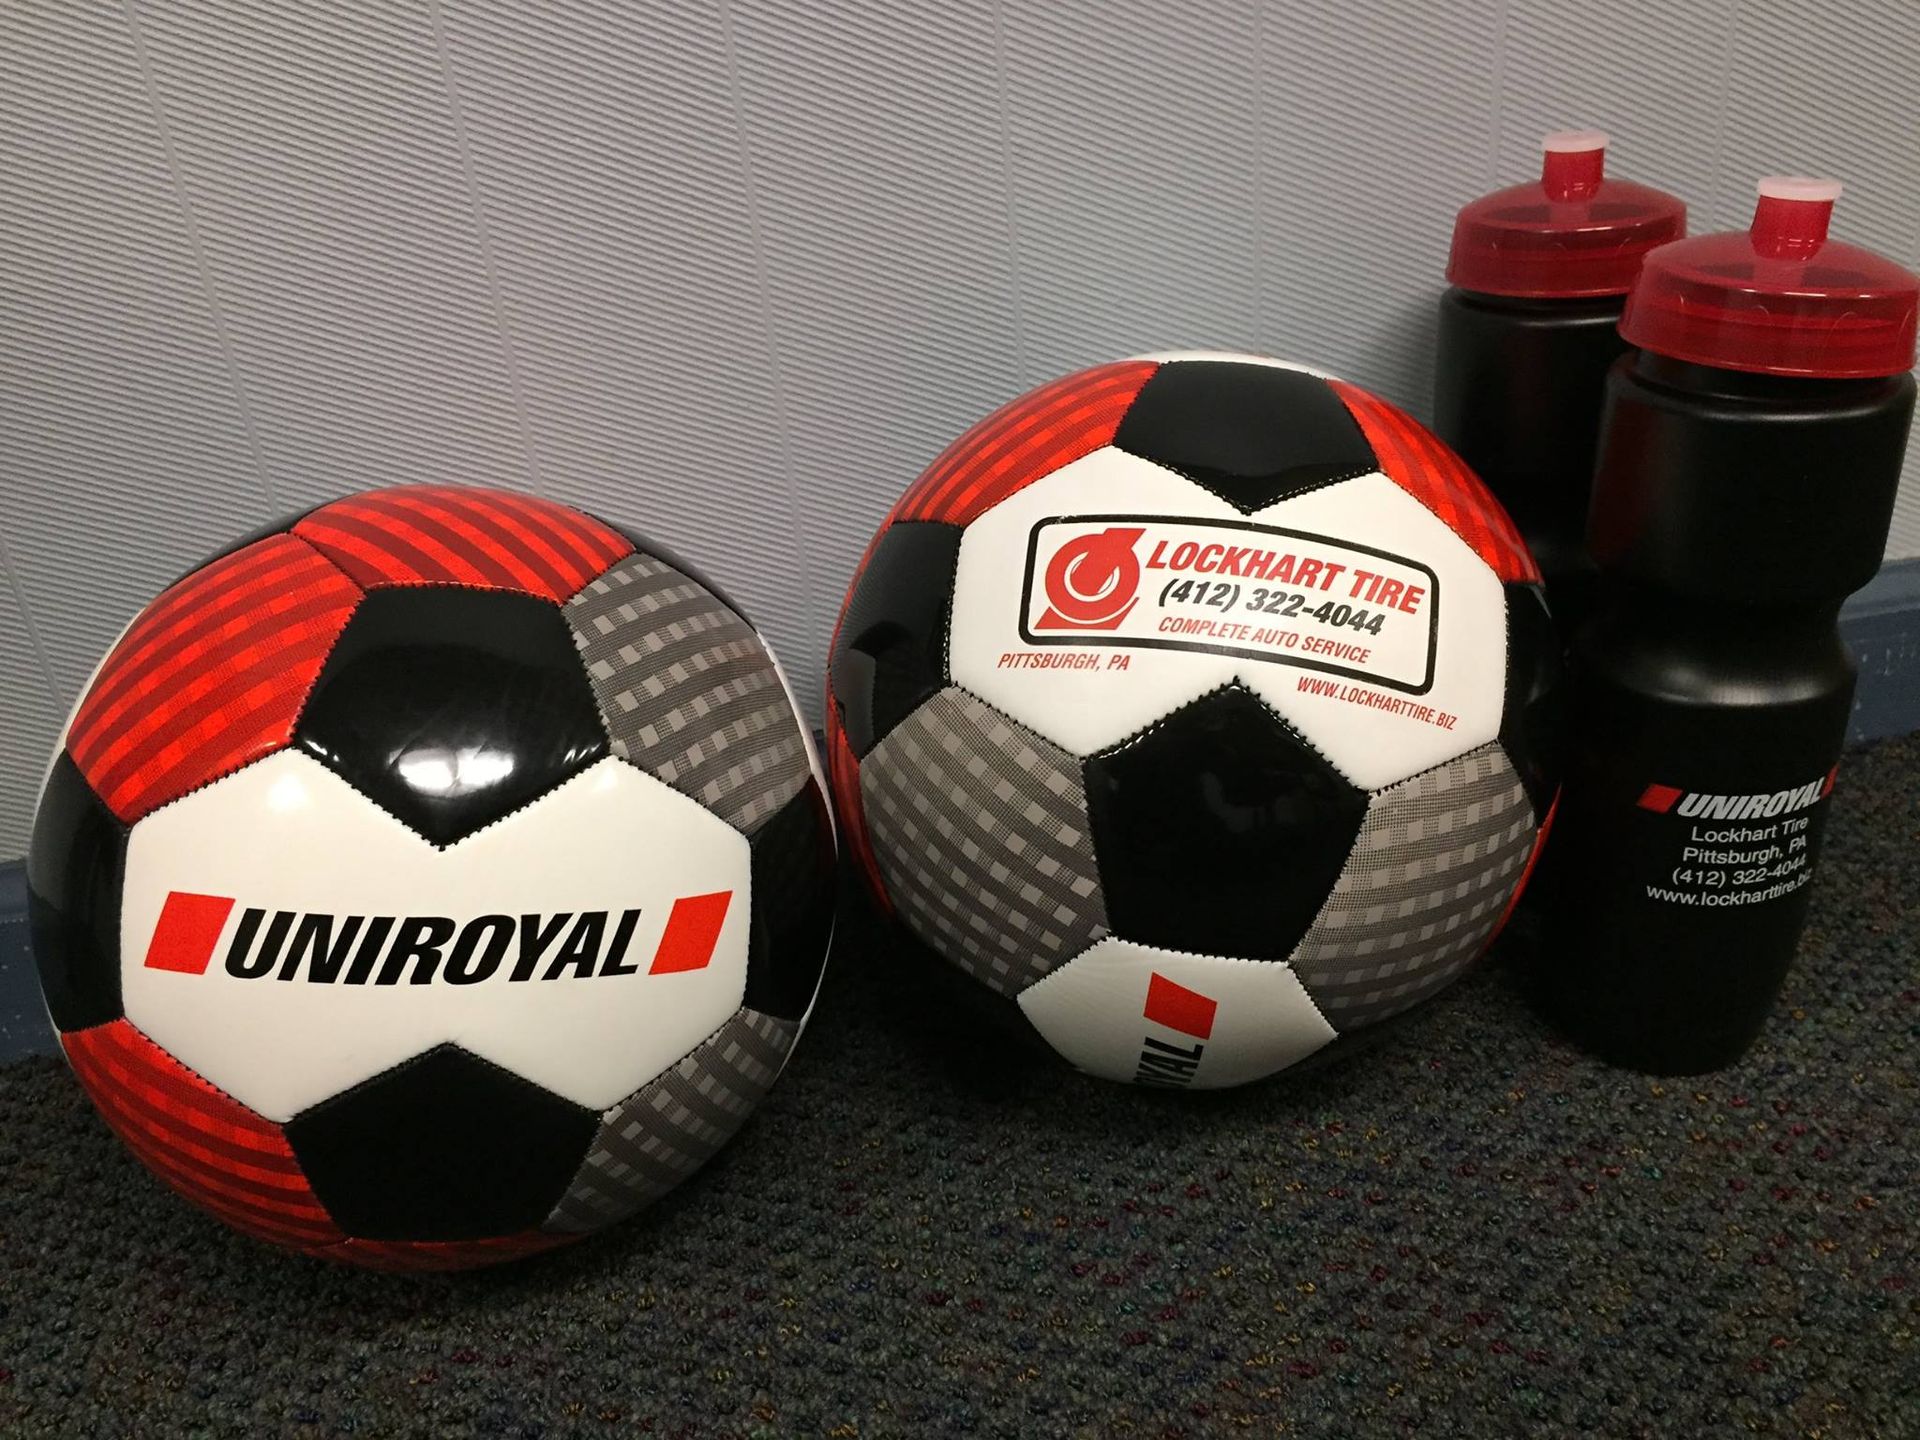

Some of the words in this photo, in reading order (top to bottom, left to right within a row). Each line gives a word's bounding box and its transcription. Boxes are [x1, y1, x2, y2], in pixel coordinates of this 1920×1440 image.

[1145, 539, 1346, 593] LOCKHART
[1352, 568, 1426, 615] TIRE
[1158, 578, 1241, 614] (412)
[1246, 586, 1388, 637] 322-4044
[997, 652, 1102, 673] PITTSBURGH,
[1106, 654, 1131, 672] PA
[1158, 616, 1250, 642] COMPLETE
[1251, 626, 1300, 650] AUTO
[1301, 635, 1372, 665] SERVICE
[1296, 676, 1459, 731] WWW.LOCKHARTTIRE.BIZ
[1676, 776, 1826, 820] UNIROYAL
[1682, 844, 1784, 866] Pittsburgh,
[1788, 833, 1807, 855] PA
[1691, 825, 1778, 844] Lockhart
[1781, 816, 1809, 836] Tire
[1672, 866, 1727, 889] (412)
[1731, 853, 1807, 886] 322-4044
[223, 907, 643, 986] UNIROYAL
